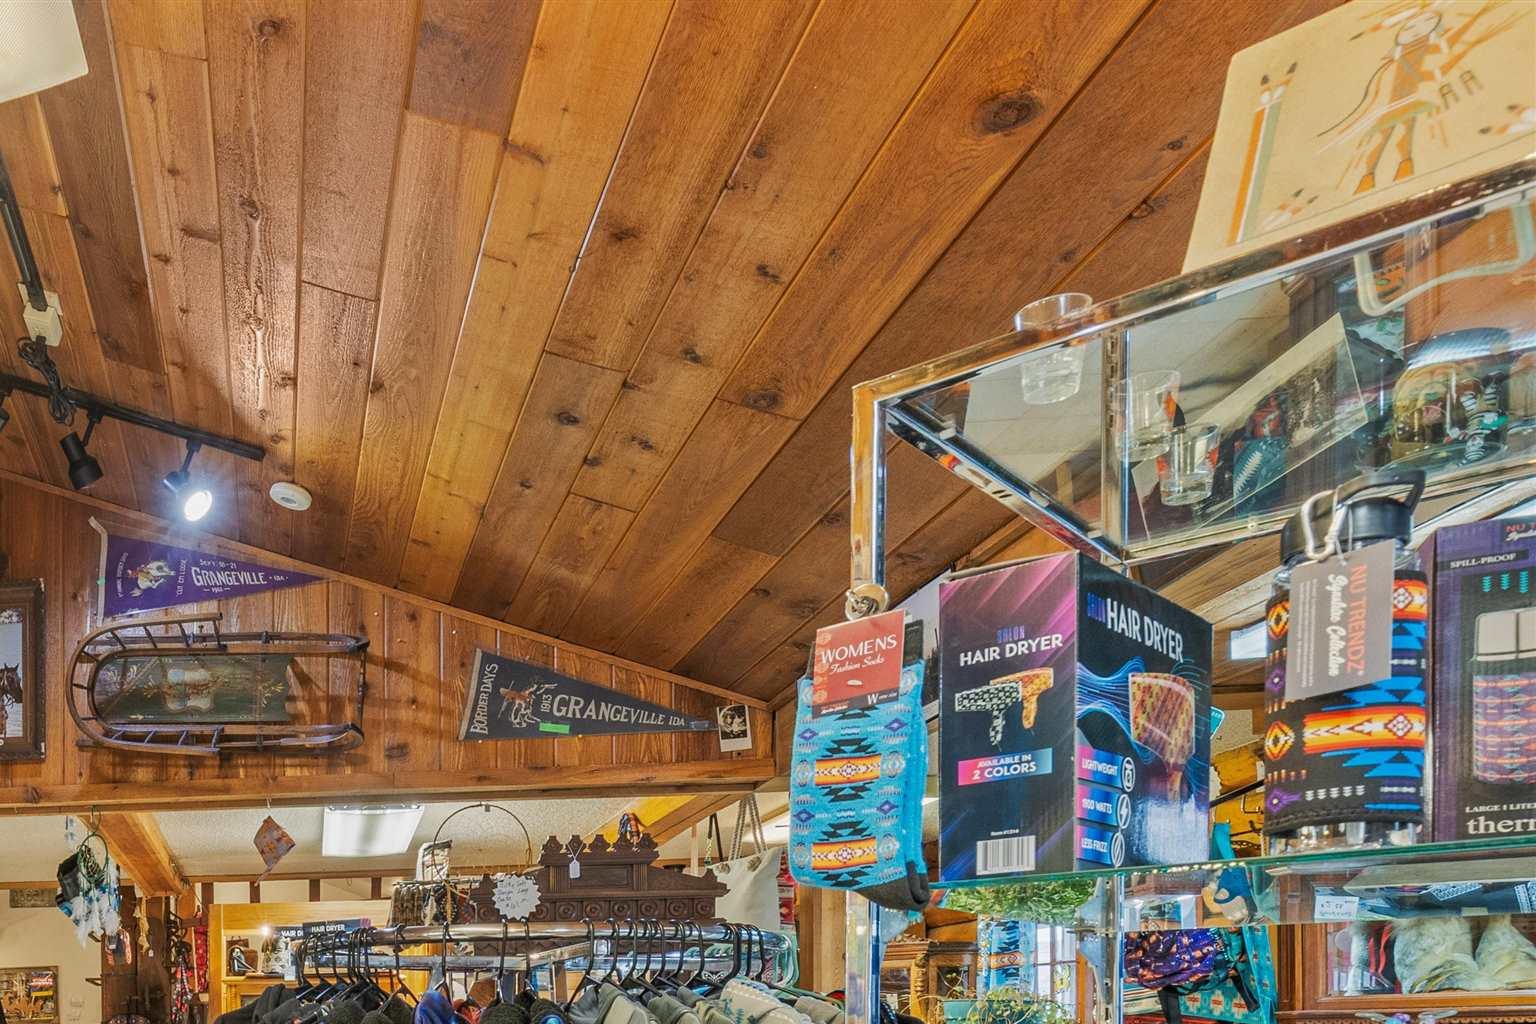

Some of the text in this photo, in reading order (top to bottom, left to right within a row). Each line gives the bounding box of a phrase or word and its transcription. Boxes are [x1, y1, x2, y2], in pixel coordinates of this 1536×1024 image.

[1449, 552, 1517, 569] SPILL-PROOF
[191, 566, 268, 587] GRANGEVILLE
[1349, 563, 1368, 594] NU
[1106, 597, 1143, 644] HAIR
[1143, 615, 1185, 663] DRYER
[820, 633, 899, 664] WOMENS
[959, 632, 1064, 668] HAIR DRYER
[828, 653, 886, 676] Fashion Socks
[470, 663, 500, 736] BORDER DAYS
[540, 694, 552, 713] 1913
[552, 694, 685, 727] GRANGEVILLE IDA
[971, 761, 1038, 781] 2 COLORS
[976, 753, 1032, 769] AVAILABLE IN
[1081, 757, 1118, 777] LIGHTWEIGHT
[1095, 800, 1113, 815] WATTS
[1465, 804, 1501, 814] LARGE
[1081, 836, 1109, 853] LESS FRIZZ
[311, 924, 346, 933] HAIR DRYER
